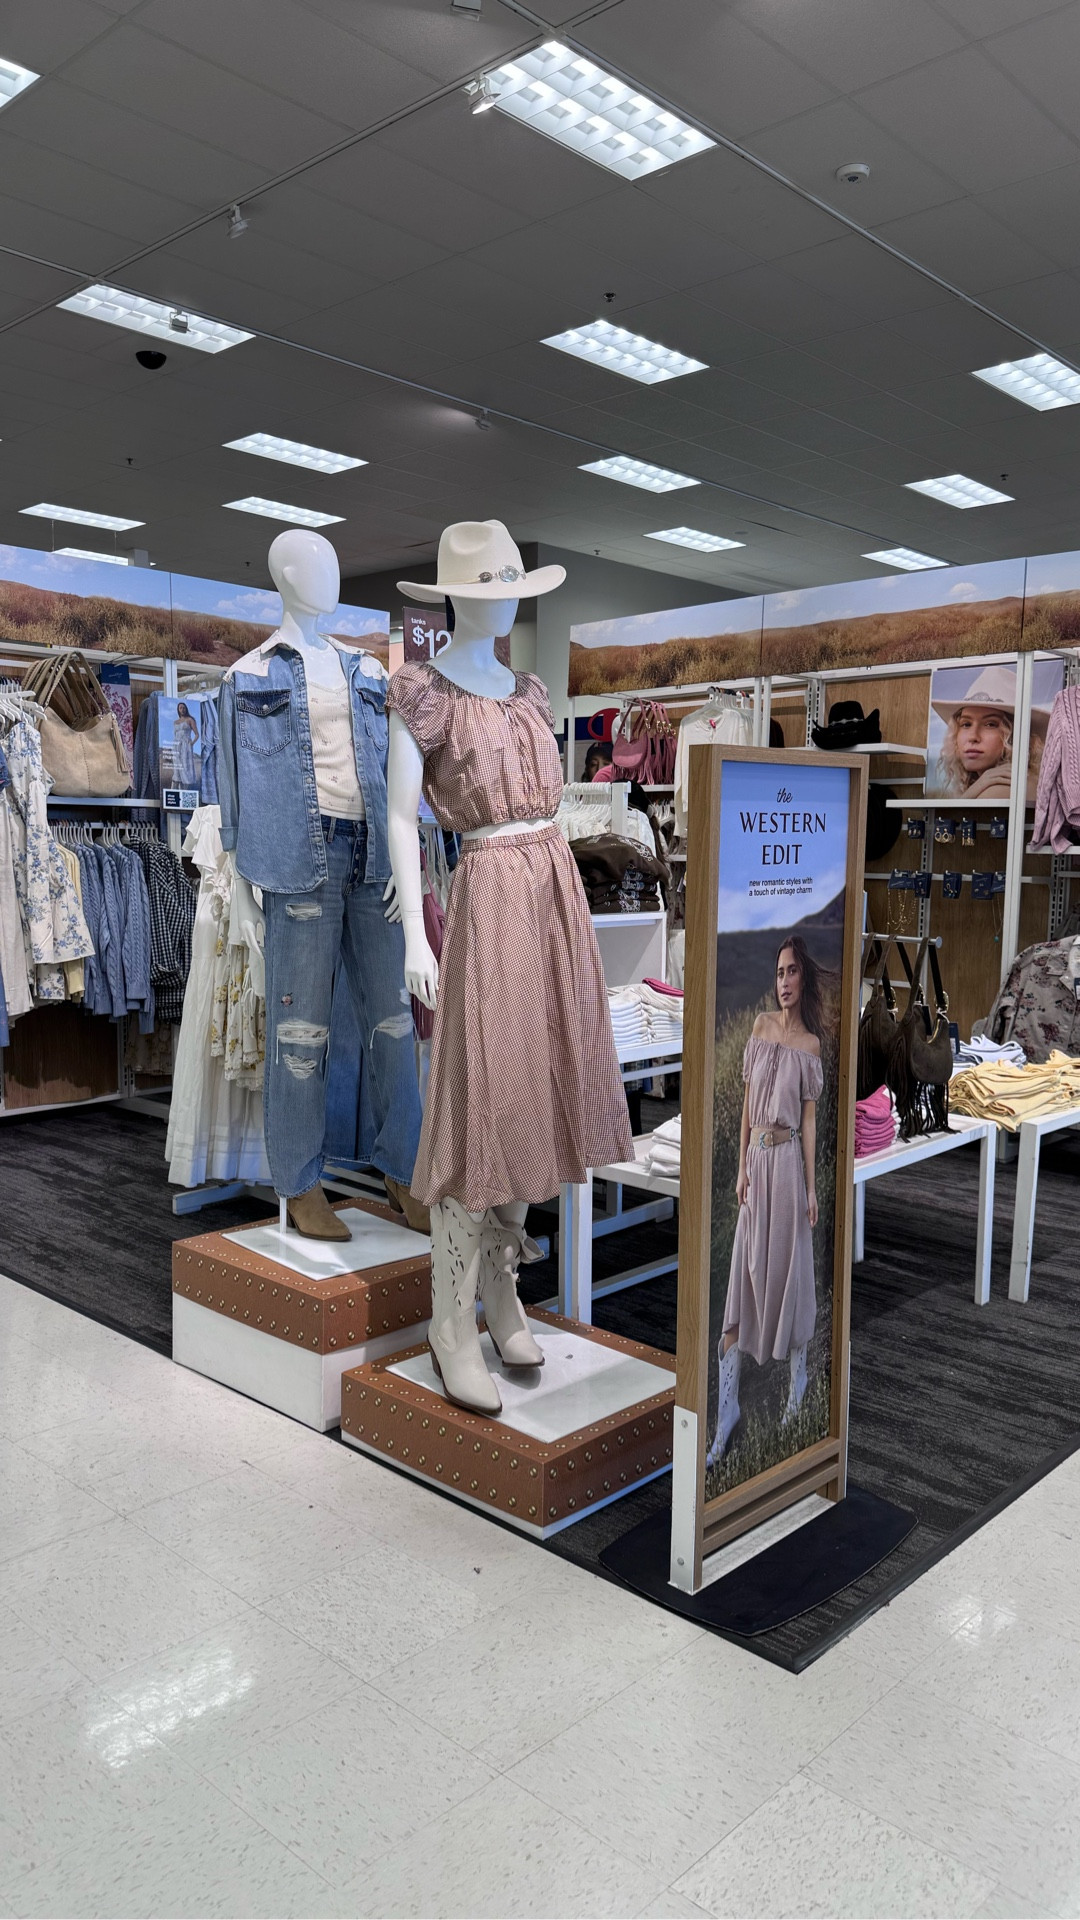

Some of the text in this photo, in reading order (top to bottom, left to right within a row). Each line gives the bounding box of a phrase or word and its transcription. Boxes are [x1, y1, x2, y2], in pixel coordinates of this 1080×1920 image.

[411, 617, 426, 625] tanks
[412, 625, 452, 658] $12
[776, 787, 793, 803] the
[740, 811, 826, 834] WESTERN
[761, 844, 802, 865] EDIT
[761, 878, 785, 886] romantic
[786, 877, 801, 887] styles
[753, 888, 769, 896] touch
[776, 887, 796, 896] vintage
[796, 886, 813, 894] charm
